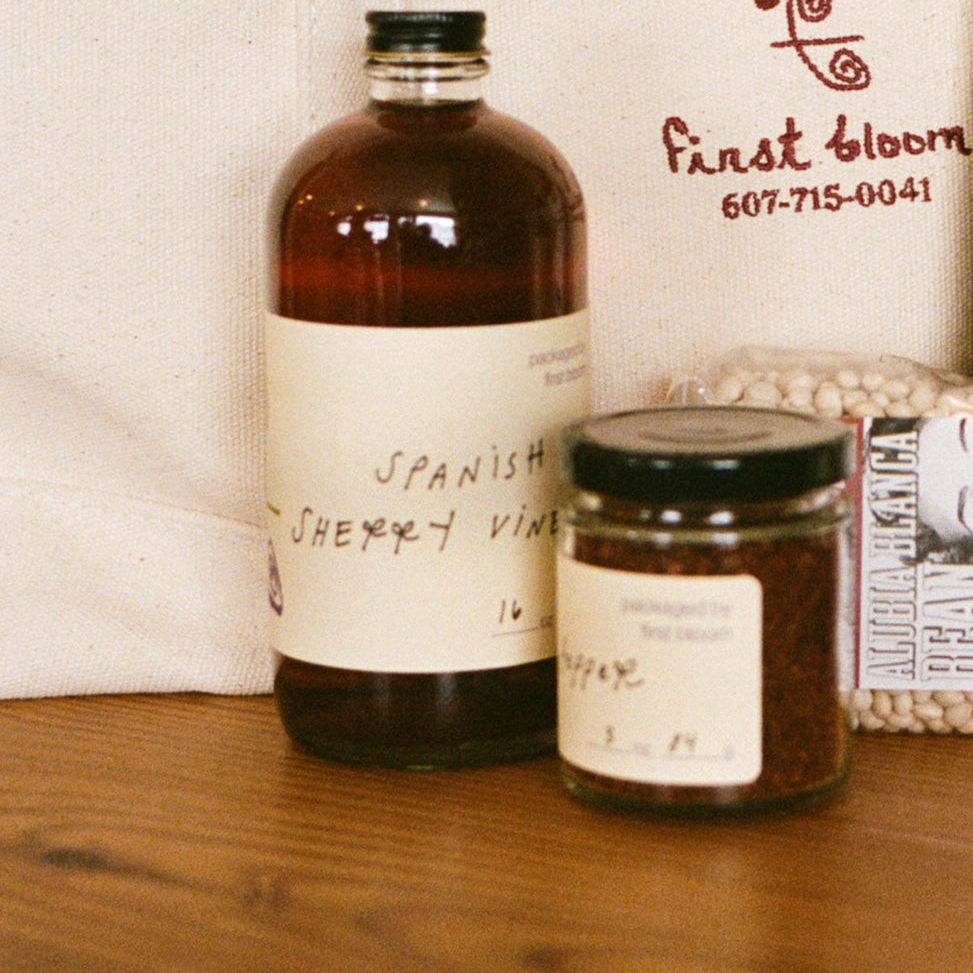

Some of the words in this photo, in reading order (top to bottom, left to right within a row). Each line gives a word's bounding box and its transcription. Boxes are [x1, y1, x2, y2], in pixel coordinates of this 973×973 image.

[662, 116, 811, 174] first
[825, 113, 972, 163] bloom
[721, 176, 932, 221] 607-715-0041
[867, 429, 919, 559] BLANCA
[499, 599, 522, 624] 16
[867, 565, 918, 681] ALUBIA
